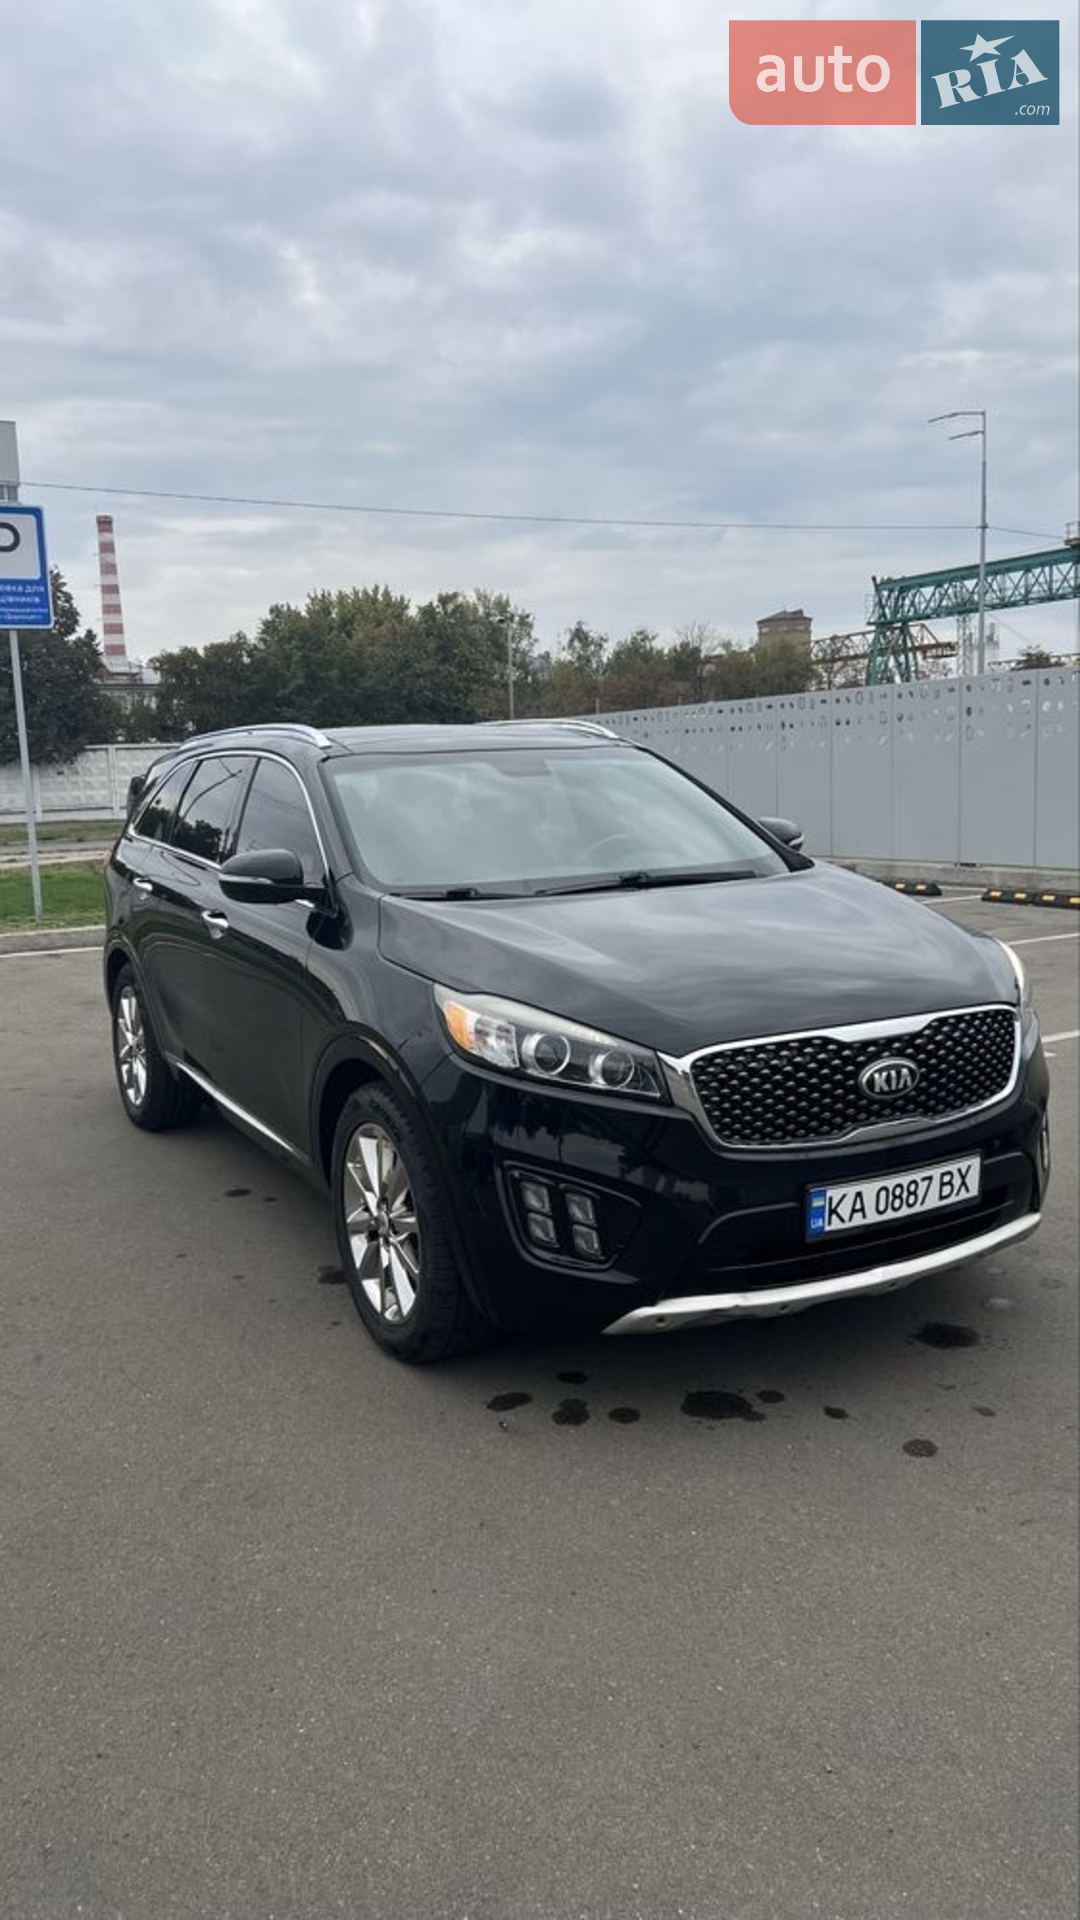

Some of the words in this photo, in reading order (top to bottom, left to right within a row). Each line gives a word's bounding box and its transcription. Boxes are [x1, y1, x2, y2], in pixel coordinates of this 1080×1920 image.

[873, 1067, 912, 1093] KIA
[827, 1190, 867, 1227] KA
[875, 1175, 933, 1216] 0887
[938, 1164, 972, 1202] BX
